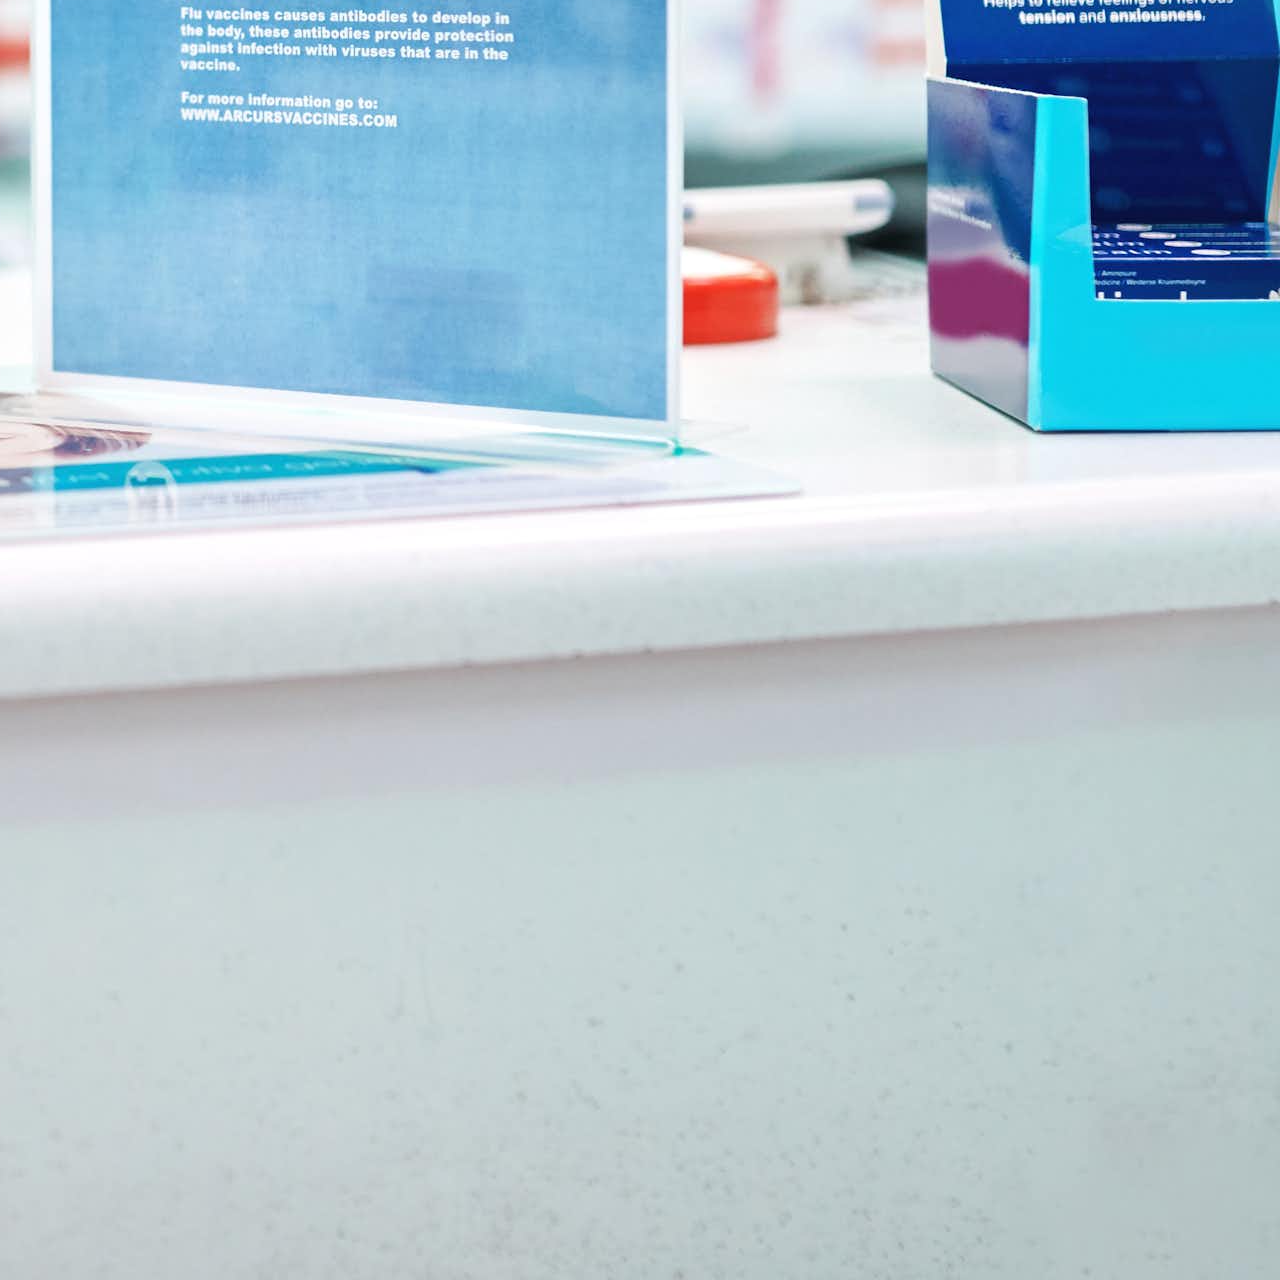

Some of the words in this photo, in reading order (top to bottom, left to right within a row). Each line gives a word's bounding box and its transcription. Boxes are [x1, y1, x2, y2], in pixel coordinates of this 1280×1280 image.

[181, 7, 202, 20] Flu
[206, 8, 270, 21] vaccines
[274, 10, 325, 22] causes
[330, 10, 408, 23] antibodies
[412, 12, 428, 23] to
[432, 12, 491, 27] develop
[496, 13, 510, 24] in
[1019, 10, 1075, 24] tension
[1079, 10, 1106, 23] and
[1110, 9, 1206, 23] anxiousness.
[180, 25, 203, 36] the
[208, 25, 245, 40] body,
[249, 26, 289, 38] these
[294, 27, 370, 40] antibodies
[374, 29, 430, 44] provide
[434, 30, 514, 45] protection
[181, 42, 233, 56] against
[238, 43, 301, 56] infection
[305, 45, 337, 57] with
[341, 46, 396, 58] viruses
[400, 46, 431, 58] that
[435, 49, 460, 59] are
[465, 47, 479, 60] in
[483, 48, 509, 61] the
[181, 59, 240, 71] vaccine.
[181, 92, 204, 104] For
[208, 95, 244, 106] more
[248, 94, 331, 108] information
[335, 99, 354, 111] go
[358, 98, 378, 109] to:
[181, 109, 398, 128] WWW.ARCURSVACCINES.COM
